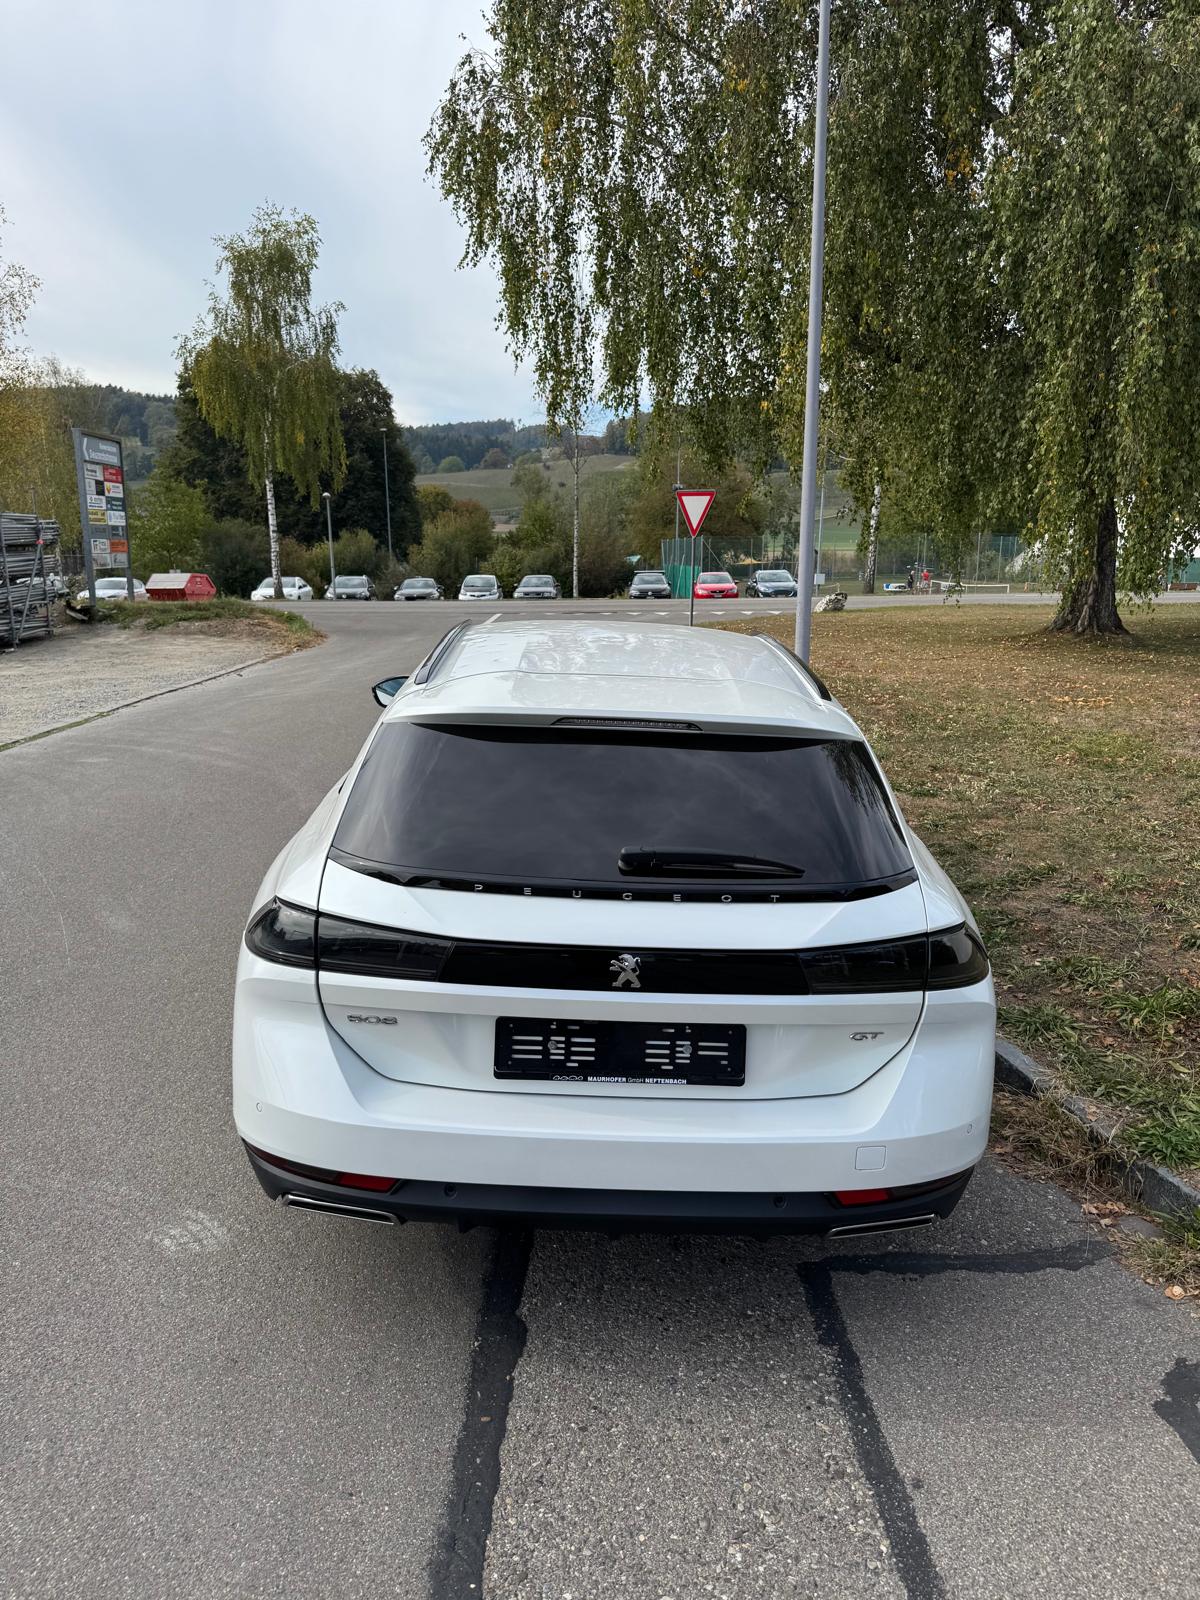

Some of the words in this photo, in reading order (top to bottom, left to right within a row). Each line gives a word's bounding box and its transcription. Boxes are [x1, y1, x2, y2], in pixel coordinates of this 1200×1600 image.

[473, 883, 781, 903] PEUGEOT
[346, 1014, 398, 1025] 508
[848, 1031, 885, 1041] GT
